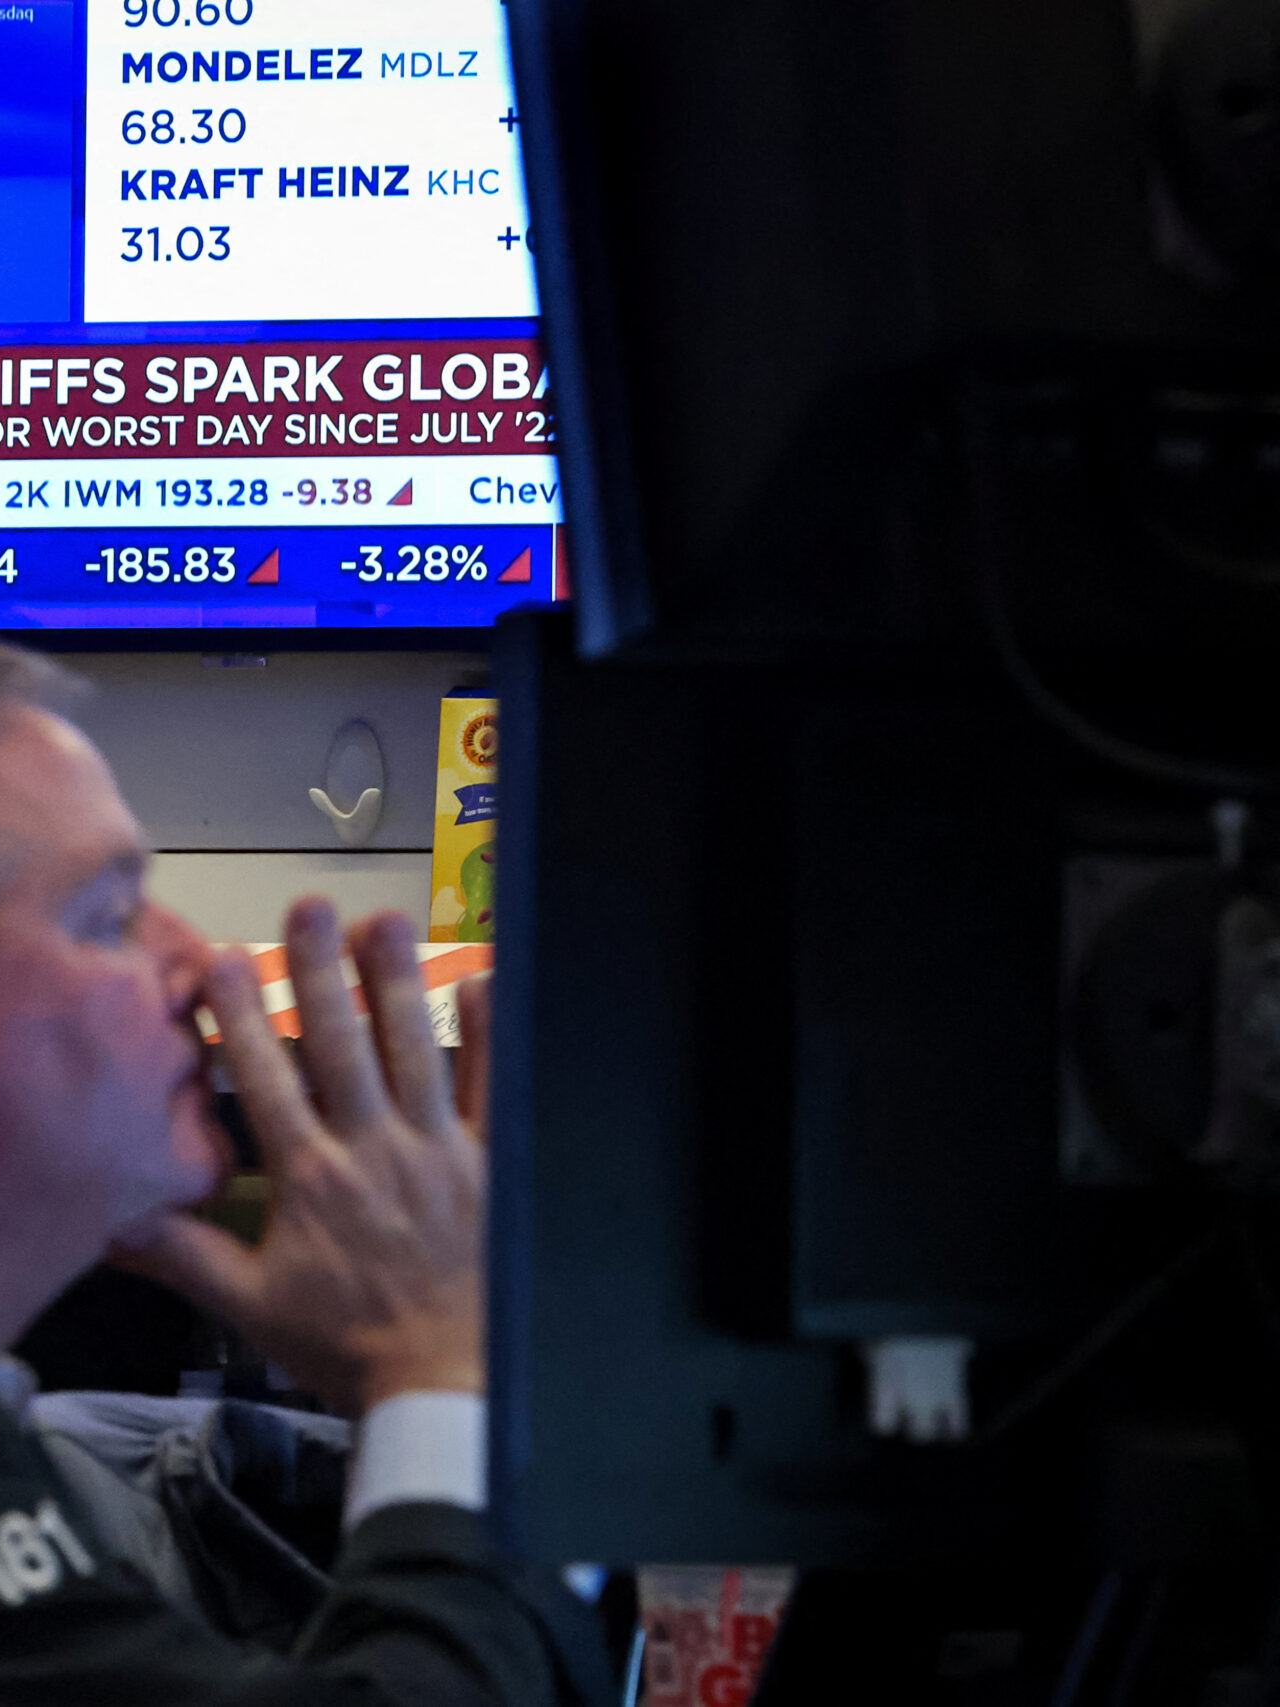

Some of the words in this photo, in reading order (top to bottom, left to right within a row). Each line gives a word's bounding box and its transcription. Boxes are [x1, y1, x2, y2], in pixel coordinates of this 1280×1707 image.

[124, 0, 253, 27] 90.60
[123, 48, 362, 83] MONDELEZ
[381, 51, 477, 78] MDLZ
[122, 108, 246, 144] 68.30
[121, 168, 263, 200] KRAFT
[279, 165, 409, 198] HEINZ
[429, 169, 499, 195] KHC
[121, 226, 230, 262] 31.03
[146, 356, 343, 403] SPARK
[43, 416, 184, 446] WORST
[197, 415, 272, 445] DAY
[285, 413, 398, 444] SINCE
[411, 412, 503, 443] JULY
[6, 481, 49, 508] 2K
[65, 480, 140, 507] IWM
[156, 479, 268, 506] 193.28
[283, 478, 372, 505] -9.38
[470, 476, 558, 504] Chev
[85, 547, 235, 582] -185.83
[341, 545, 488, 581] -3.28%
